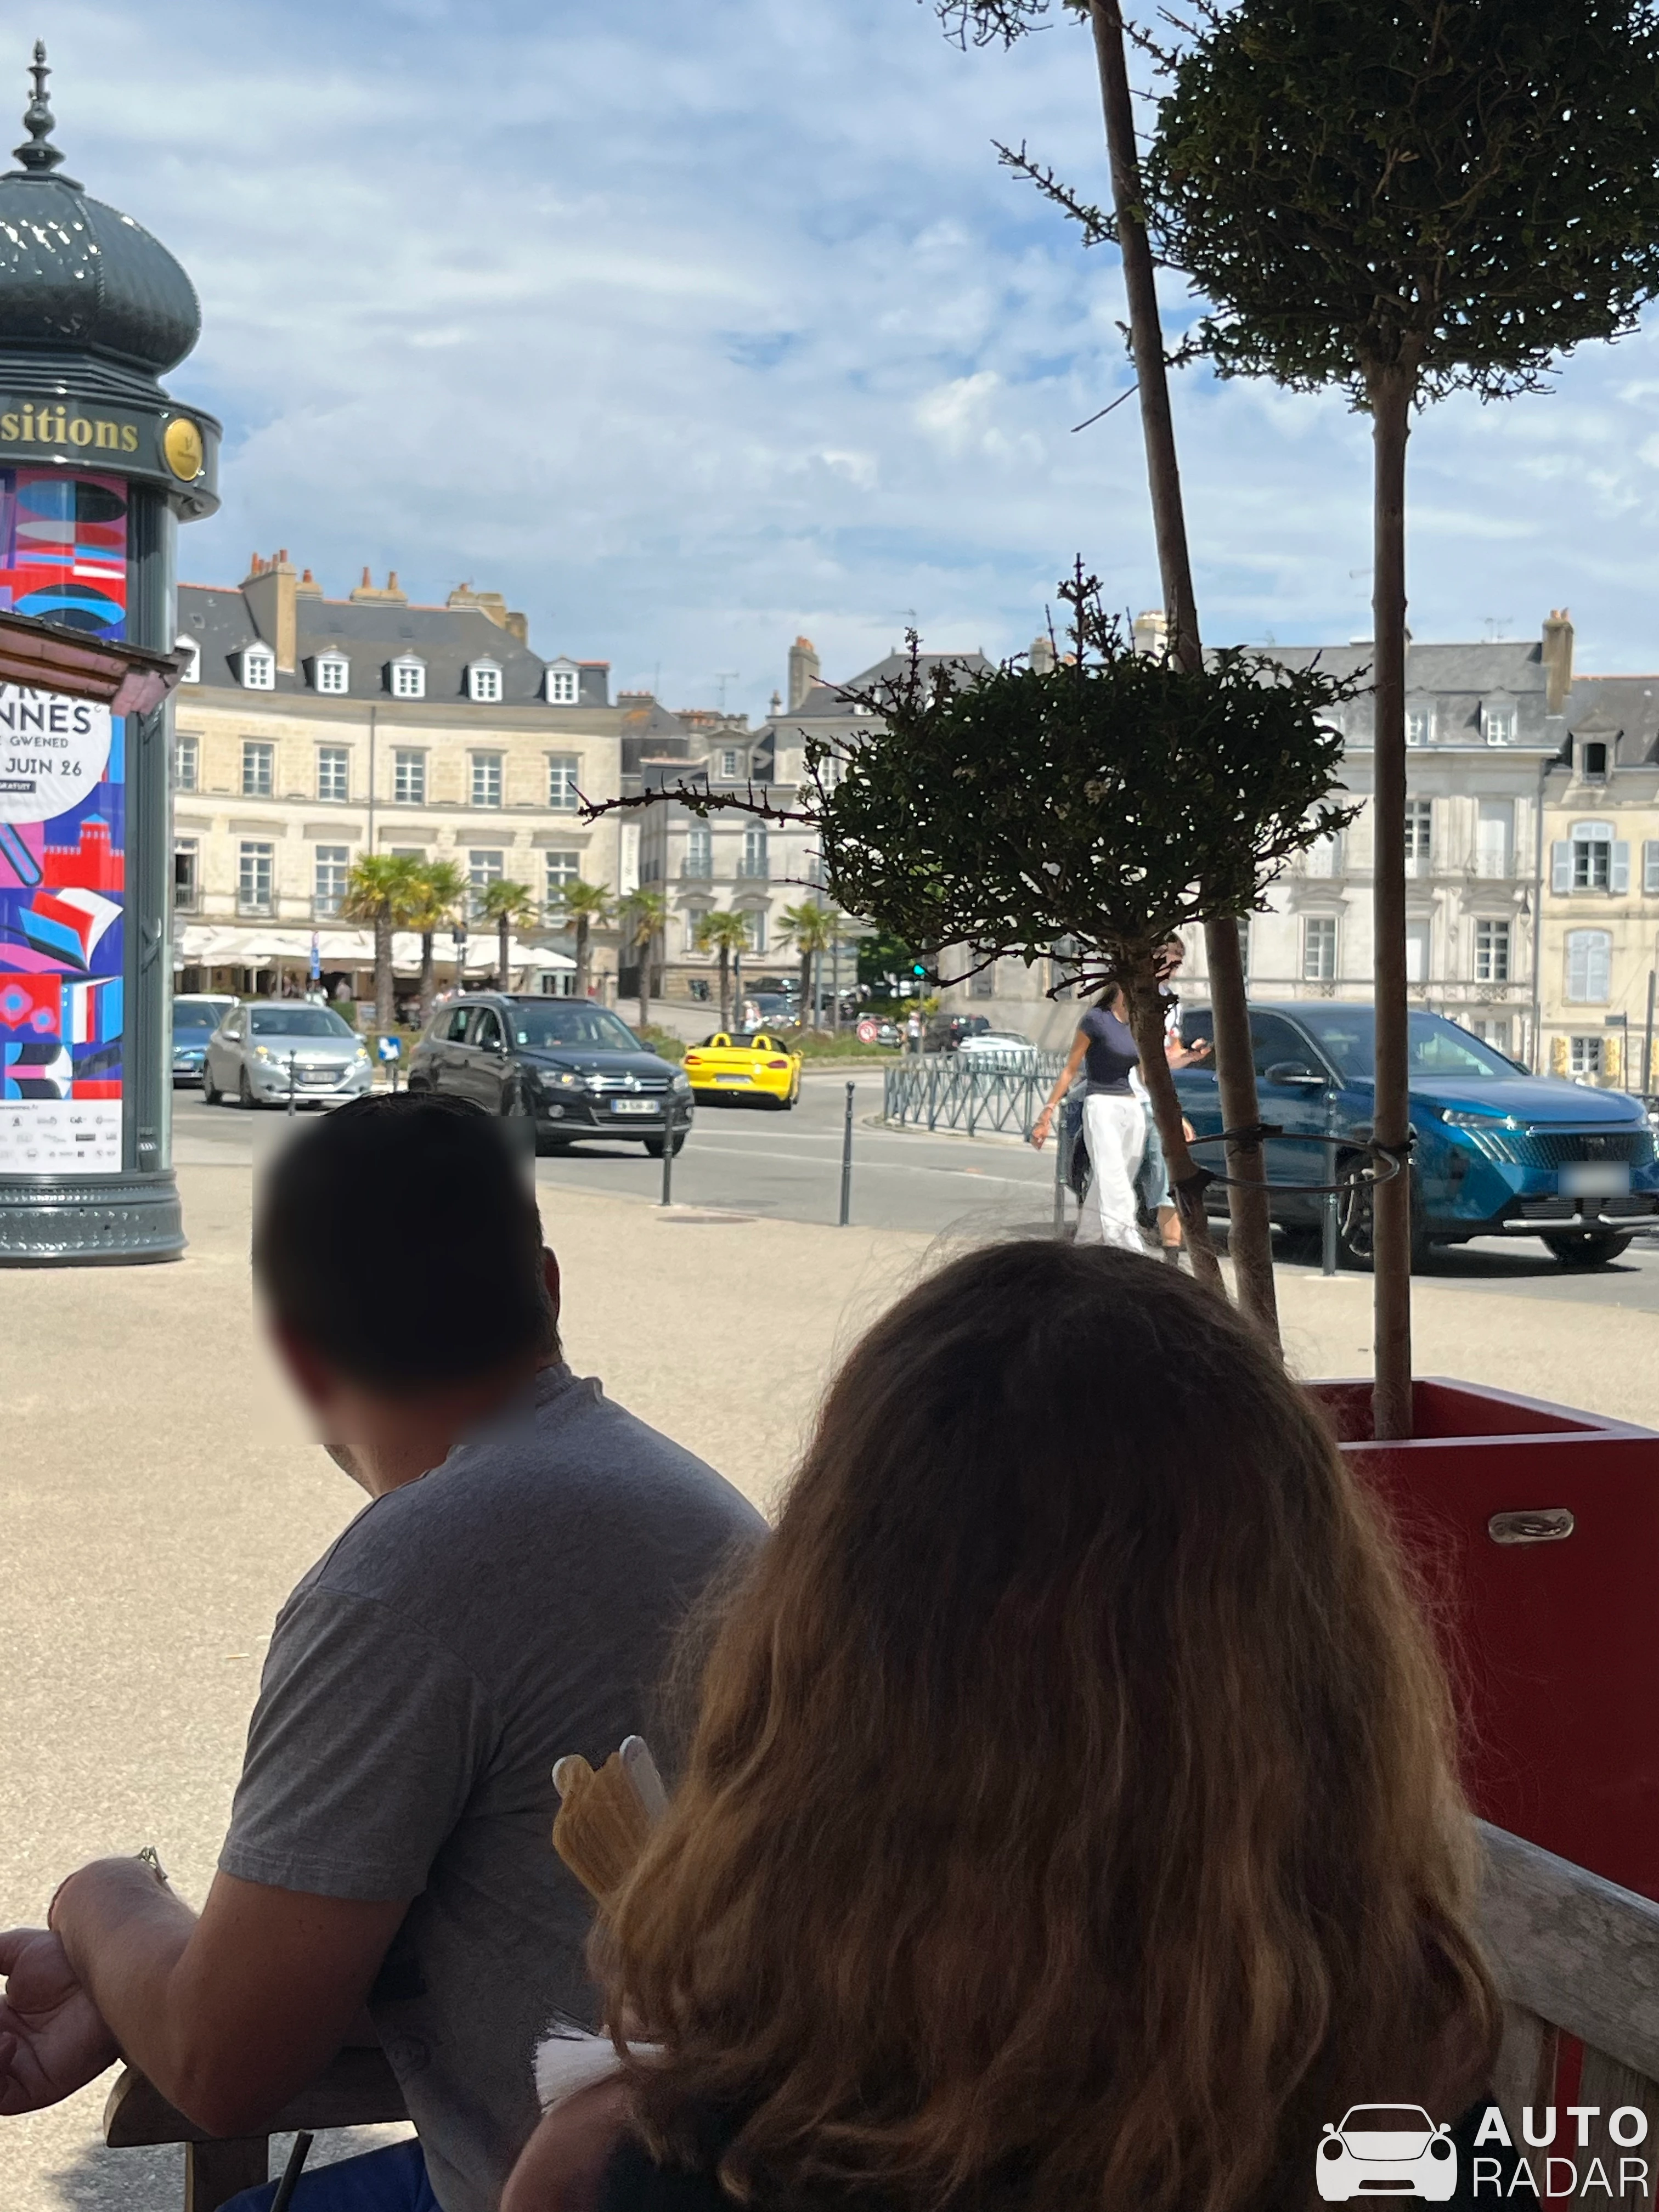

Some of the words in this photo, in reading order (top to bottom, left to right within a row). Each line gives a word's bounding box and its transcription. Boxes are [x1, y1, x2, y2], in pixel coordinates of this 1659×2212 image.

[1, 403, 138, 452] sitions
[9, 736, 69, 748] GWENED
[5, 758, 53, 774] JUIN
[60, 760, 82, 776] 26
